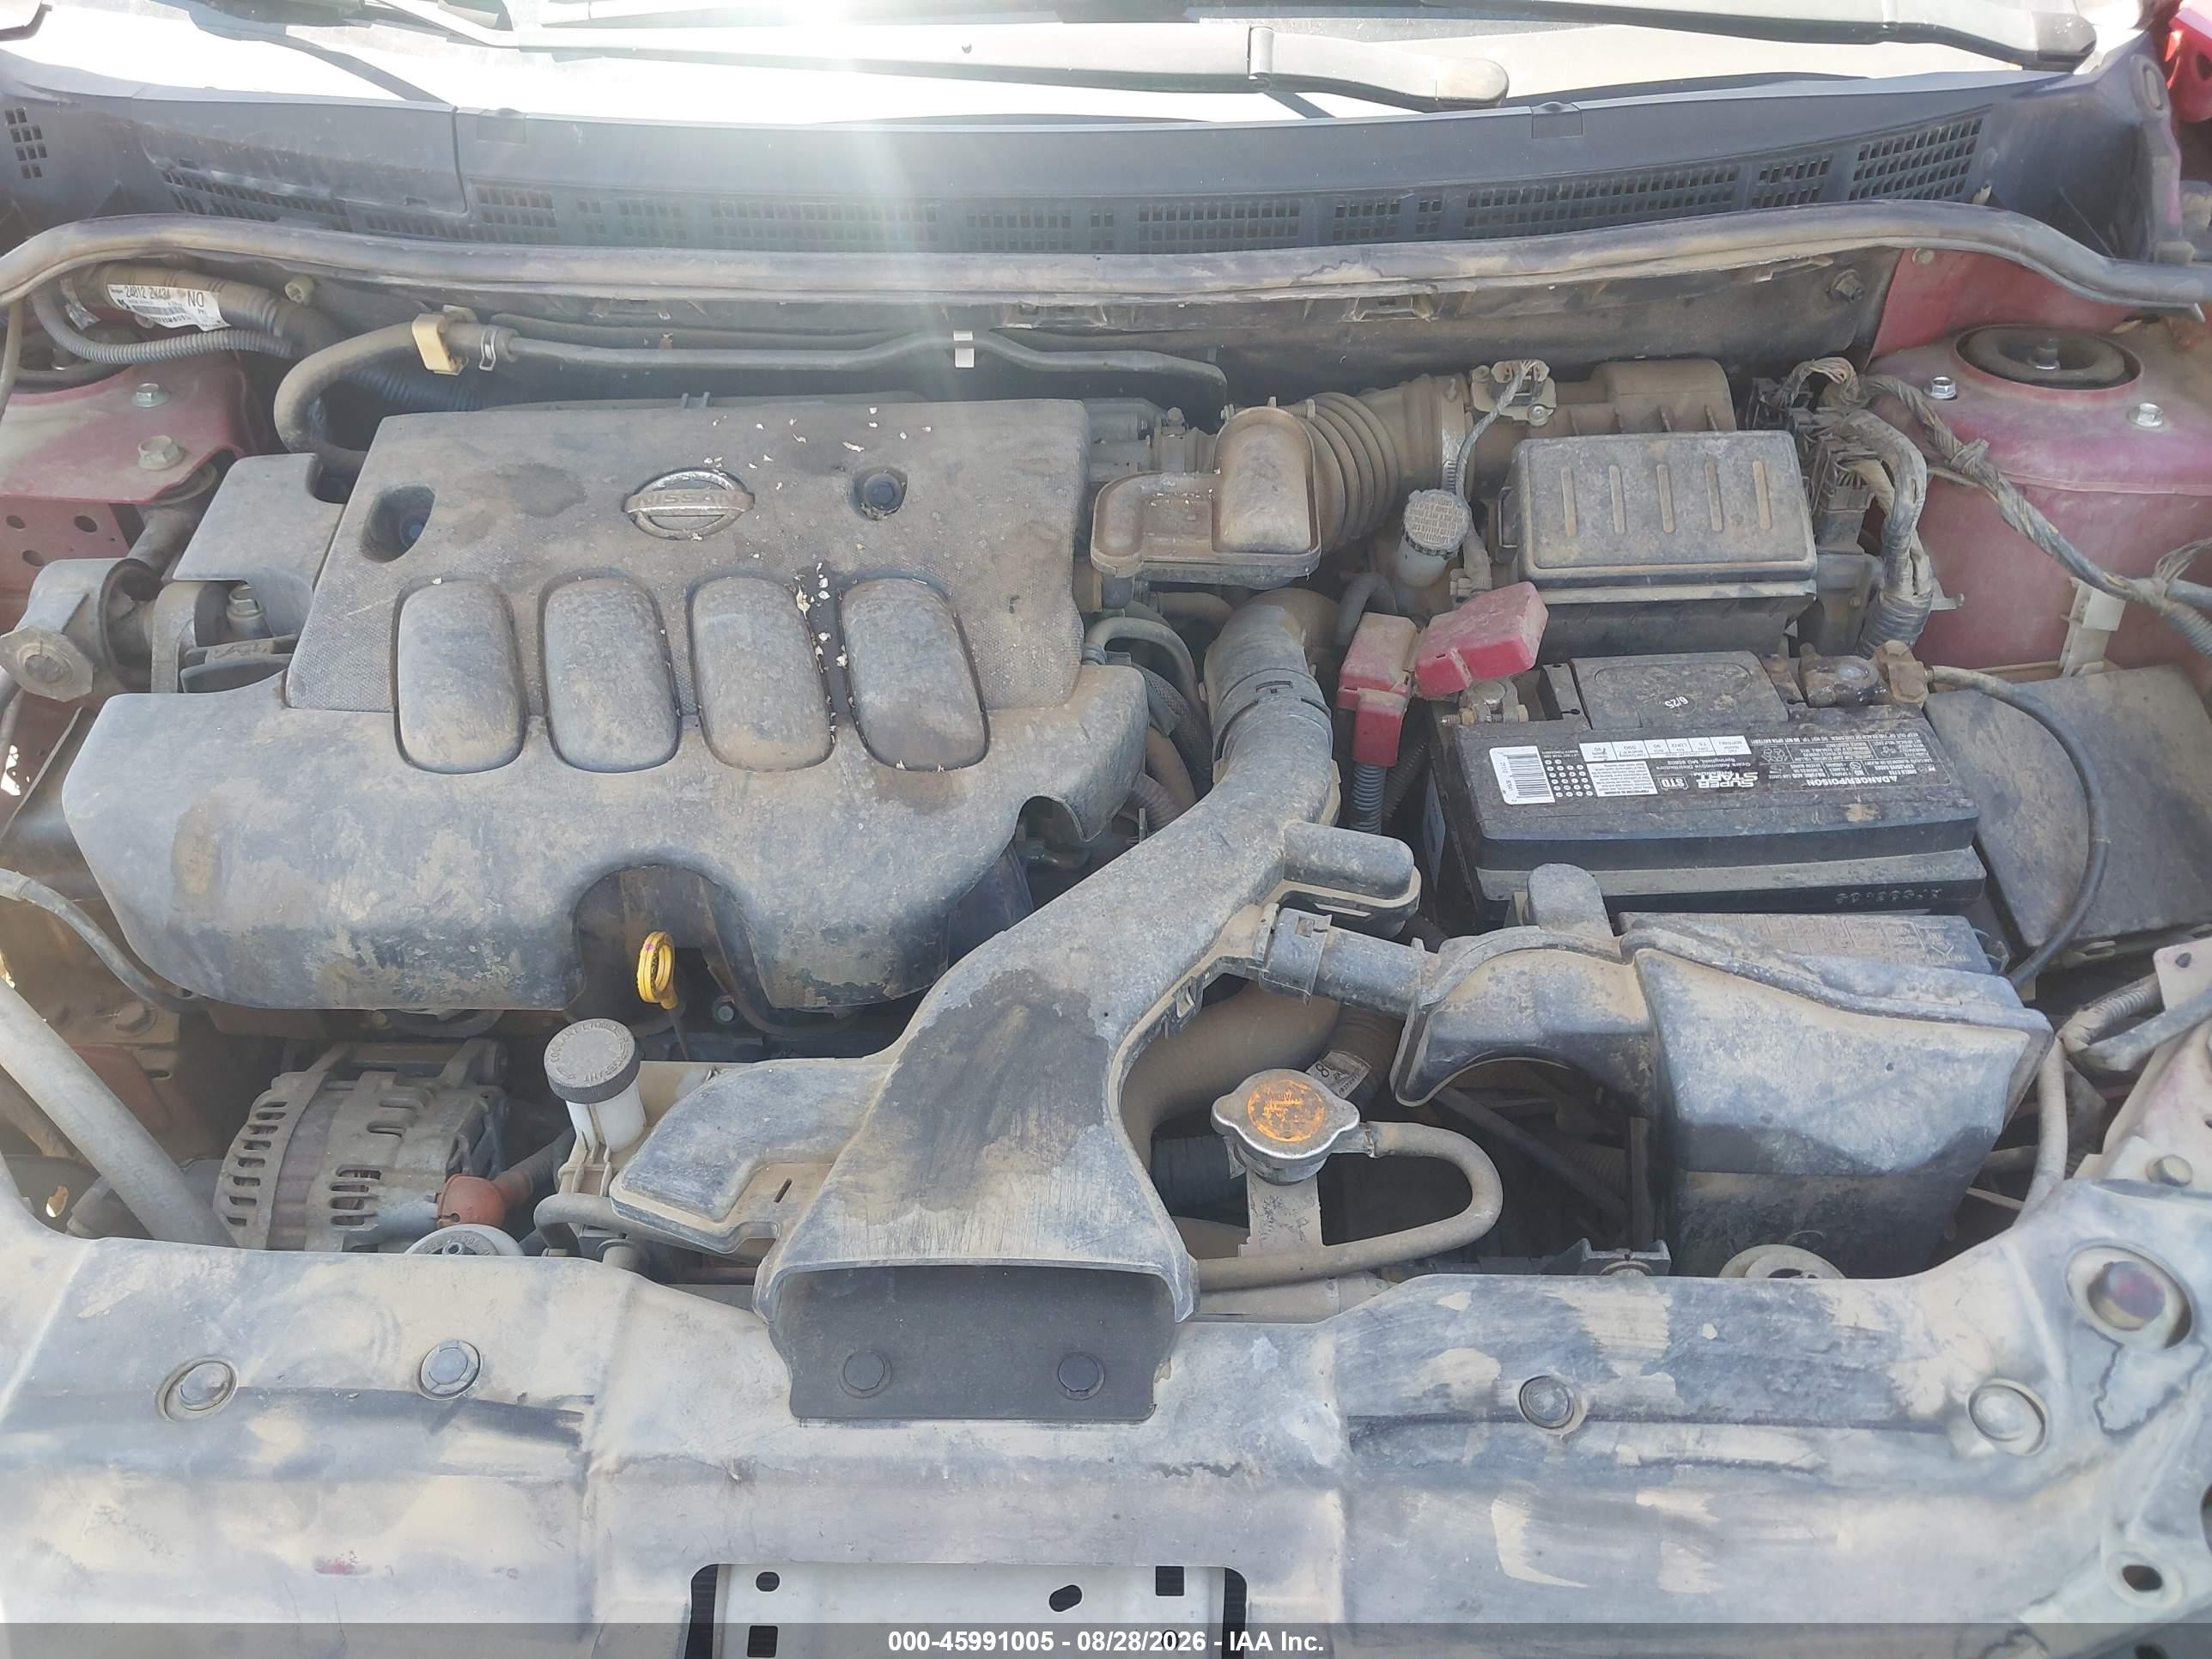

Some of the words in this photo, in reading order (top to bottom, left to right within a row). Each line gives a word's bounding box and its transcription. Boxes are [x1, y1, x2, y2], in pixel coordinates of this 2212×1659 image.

[639, 493, 742, 506] NISSAN
[1664, 696, 1689, 709] 6/25
[1696, 772, 1758, 781] START
[1807, 776, 1889, 786] DANGER/POISON
[1316, 1064, 1329, 1078] 8
